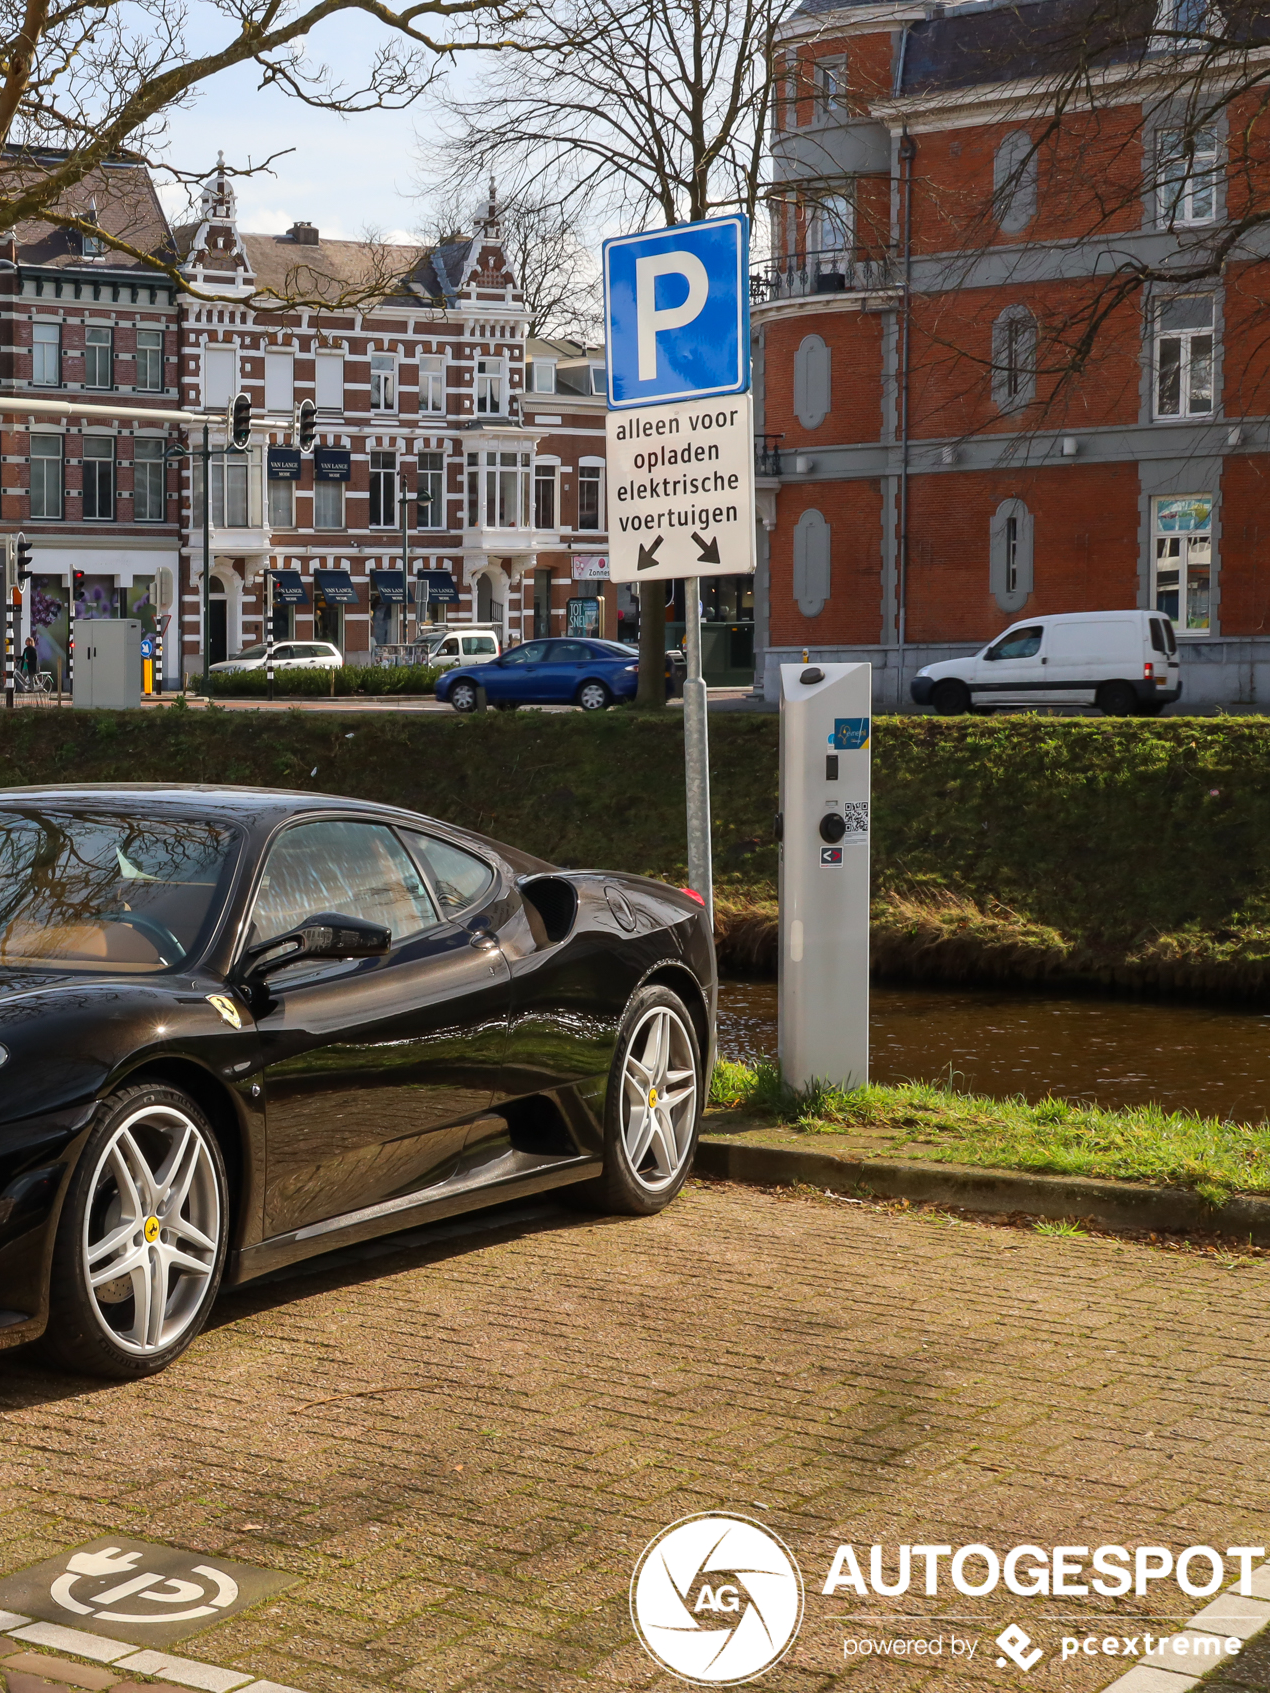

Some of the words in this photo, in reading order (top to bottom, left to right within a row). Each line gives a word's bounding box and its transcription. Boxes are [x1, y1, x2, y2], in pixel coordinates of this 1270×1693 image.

[636, 249, 709, 382] P
[616, 417, 680, 441] alleen
[688, 409, 739, 432] voor
[633, 441, 719, 474] opladen
[616, 470, 739, 502] elektrische
[618, 503, 738, 532] voertuigen
[569, 603, 582, 616] TOT
[569, 616, 587, 628] SNEL
